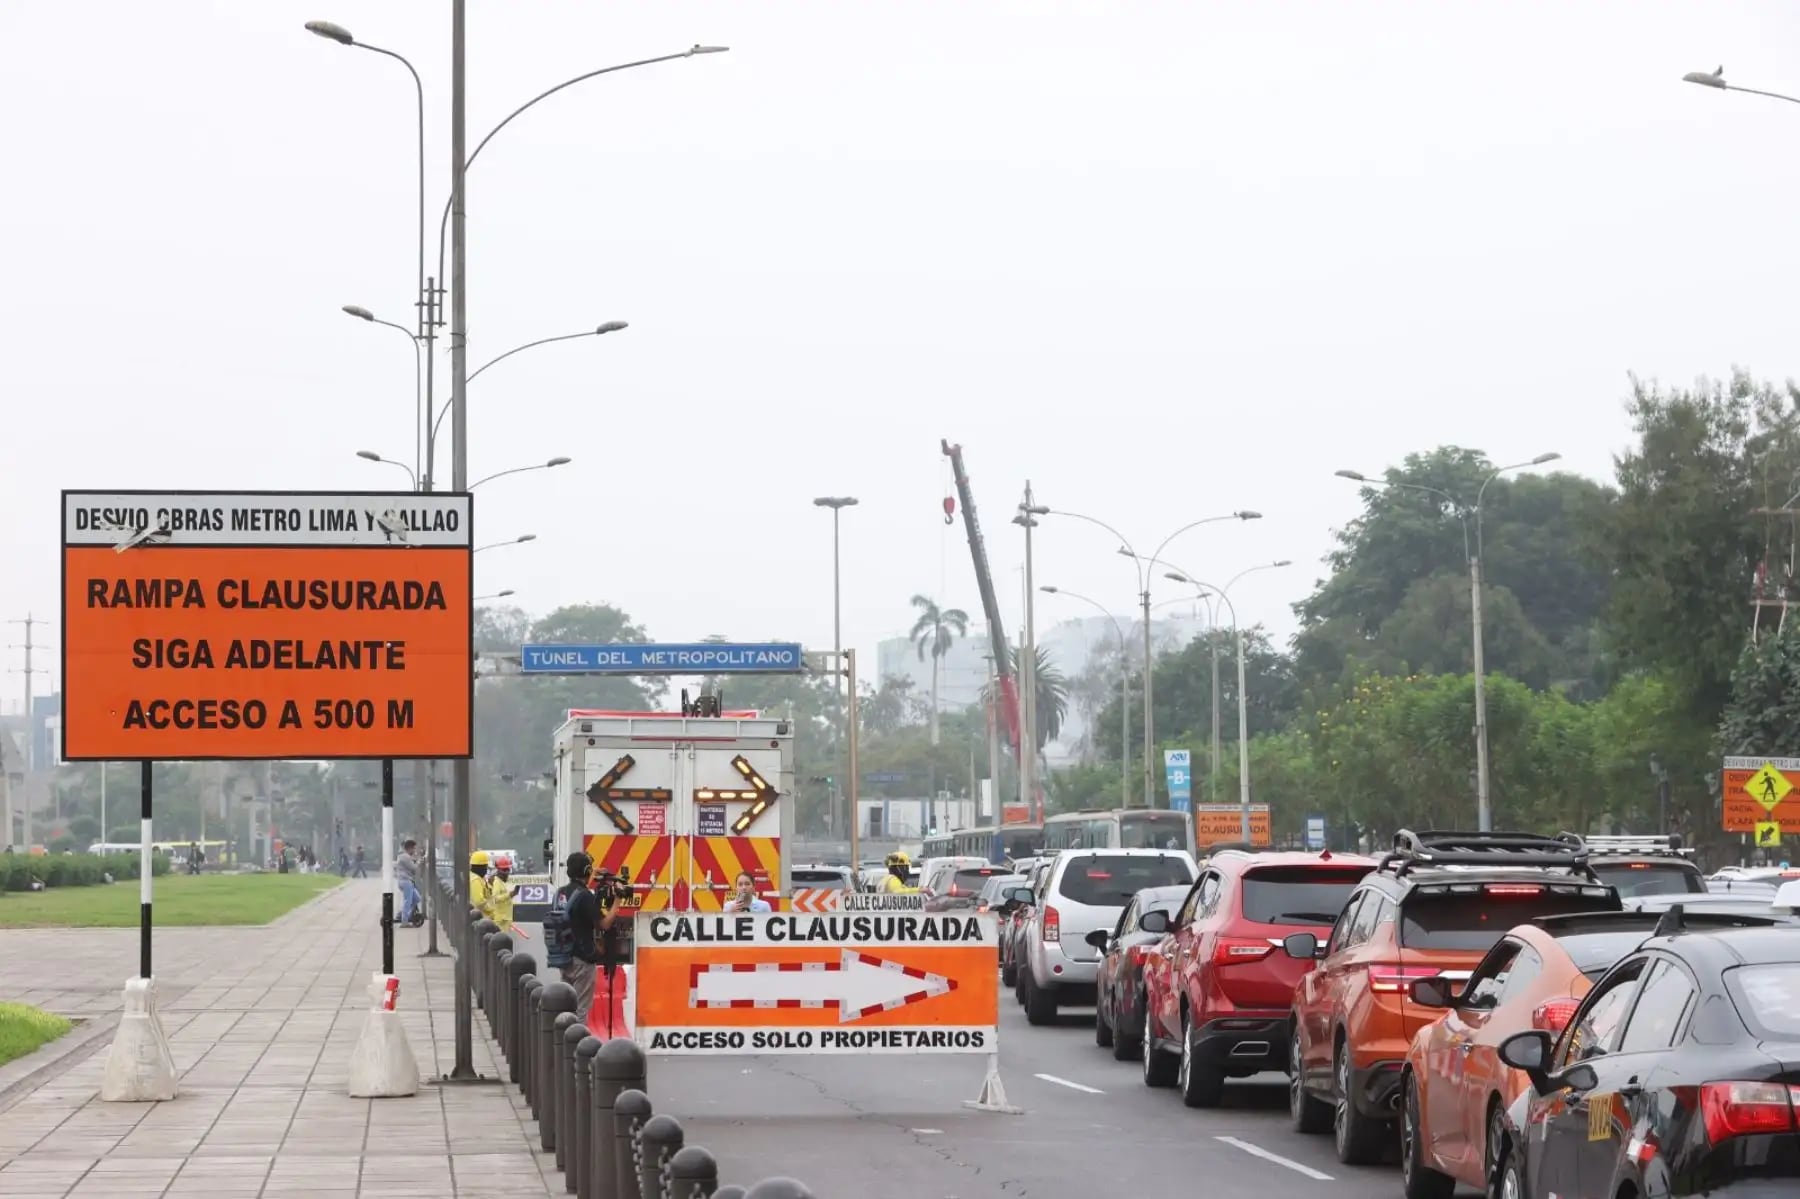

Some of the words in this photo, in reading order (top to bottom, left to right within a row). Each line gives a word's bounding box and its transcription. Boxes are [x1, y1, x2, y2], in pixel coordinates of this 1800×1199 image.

[77, 508, 148, 531] DESVIO
[157, 508, 224, 531] OBRAS
[232, 508, 300, 531] METRO
[309, 509, 358, 531] LIMA
[364, 509, 374, 531] Y
[384, 509, 459, 531] ALLAO
[88, 579, 206, 608] RAMPA
[217, 579, 446, 610] CLAUSURADA
[133, 639, 214, 668] SIGA
[225, 640, 406, 669] ADELANTE
[530, 649, 588, 665] TÚNEL
[598, 651, 632, 664] DEL
[641, 650, 793, 664] METROPOLITANO
[123, 700, 266, 729] ACCESO
[279, 700, 302, 729] A
[314, 700, 375, 729] 500
[388, 700, 414, 728] M
[1201, 824, 1266, 834] CLAUSUADA
[524, 886, 545, 900] 29
[844, 895, 870, 911] CALLE
[872, 895, 923, 910] CLAUSURADA
[650, 917, 754, 942] CALLE
[765, 916, 983, 942] CLAUSURADA
[650, 1031, 745, 1048] ACCESO
[752, 1030, 813, 1048] SOLO
[820, 1030, 984, 1048] PROPIETARIOS
